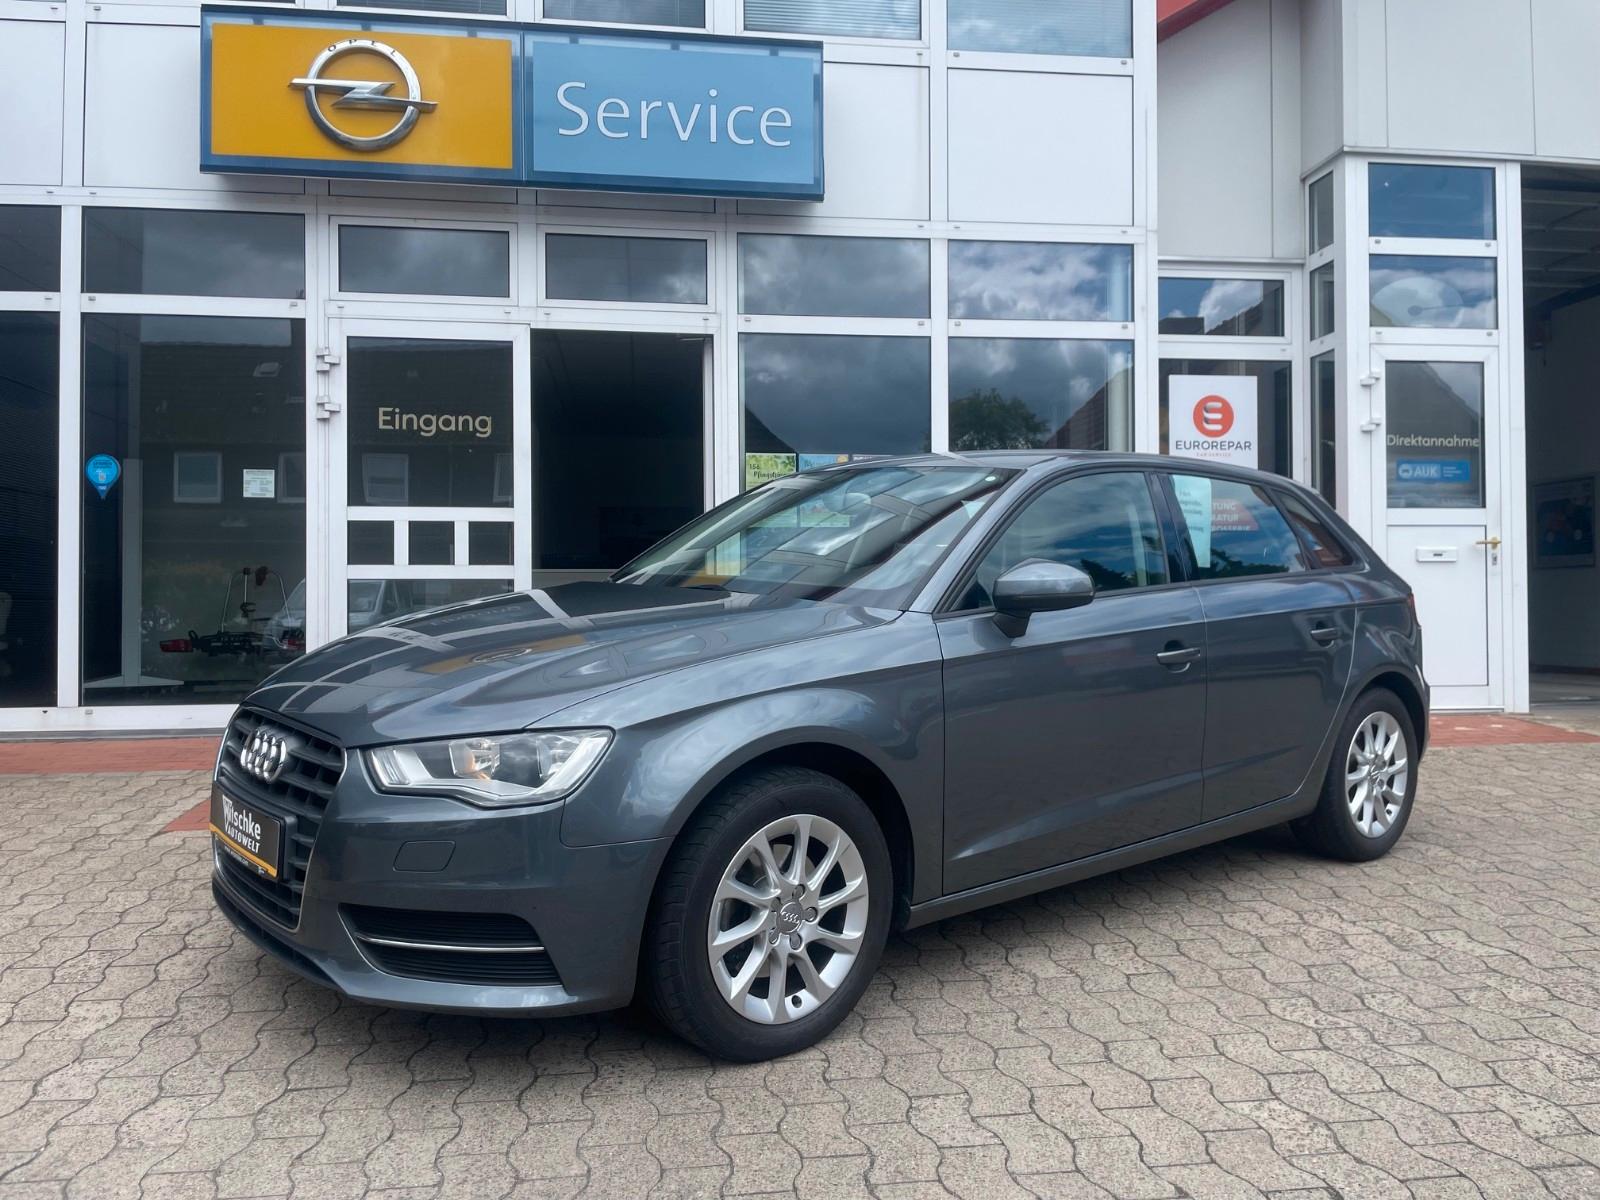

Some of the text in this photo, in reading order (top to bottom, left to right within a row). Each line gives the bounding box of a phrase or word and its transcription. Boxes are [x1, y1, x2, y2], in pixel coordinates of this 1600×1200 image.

[327, 38, 397, 58] OPEL
[555, 81, 793, 147] Service
[378, 407, 492, 438] Eingang
[1175, 440, 1252, 450] EUROREPAR
[1386, 434, 1480, 447] Direktannahme
[227, 824, 260, 854] AUTOWELT
